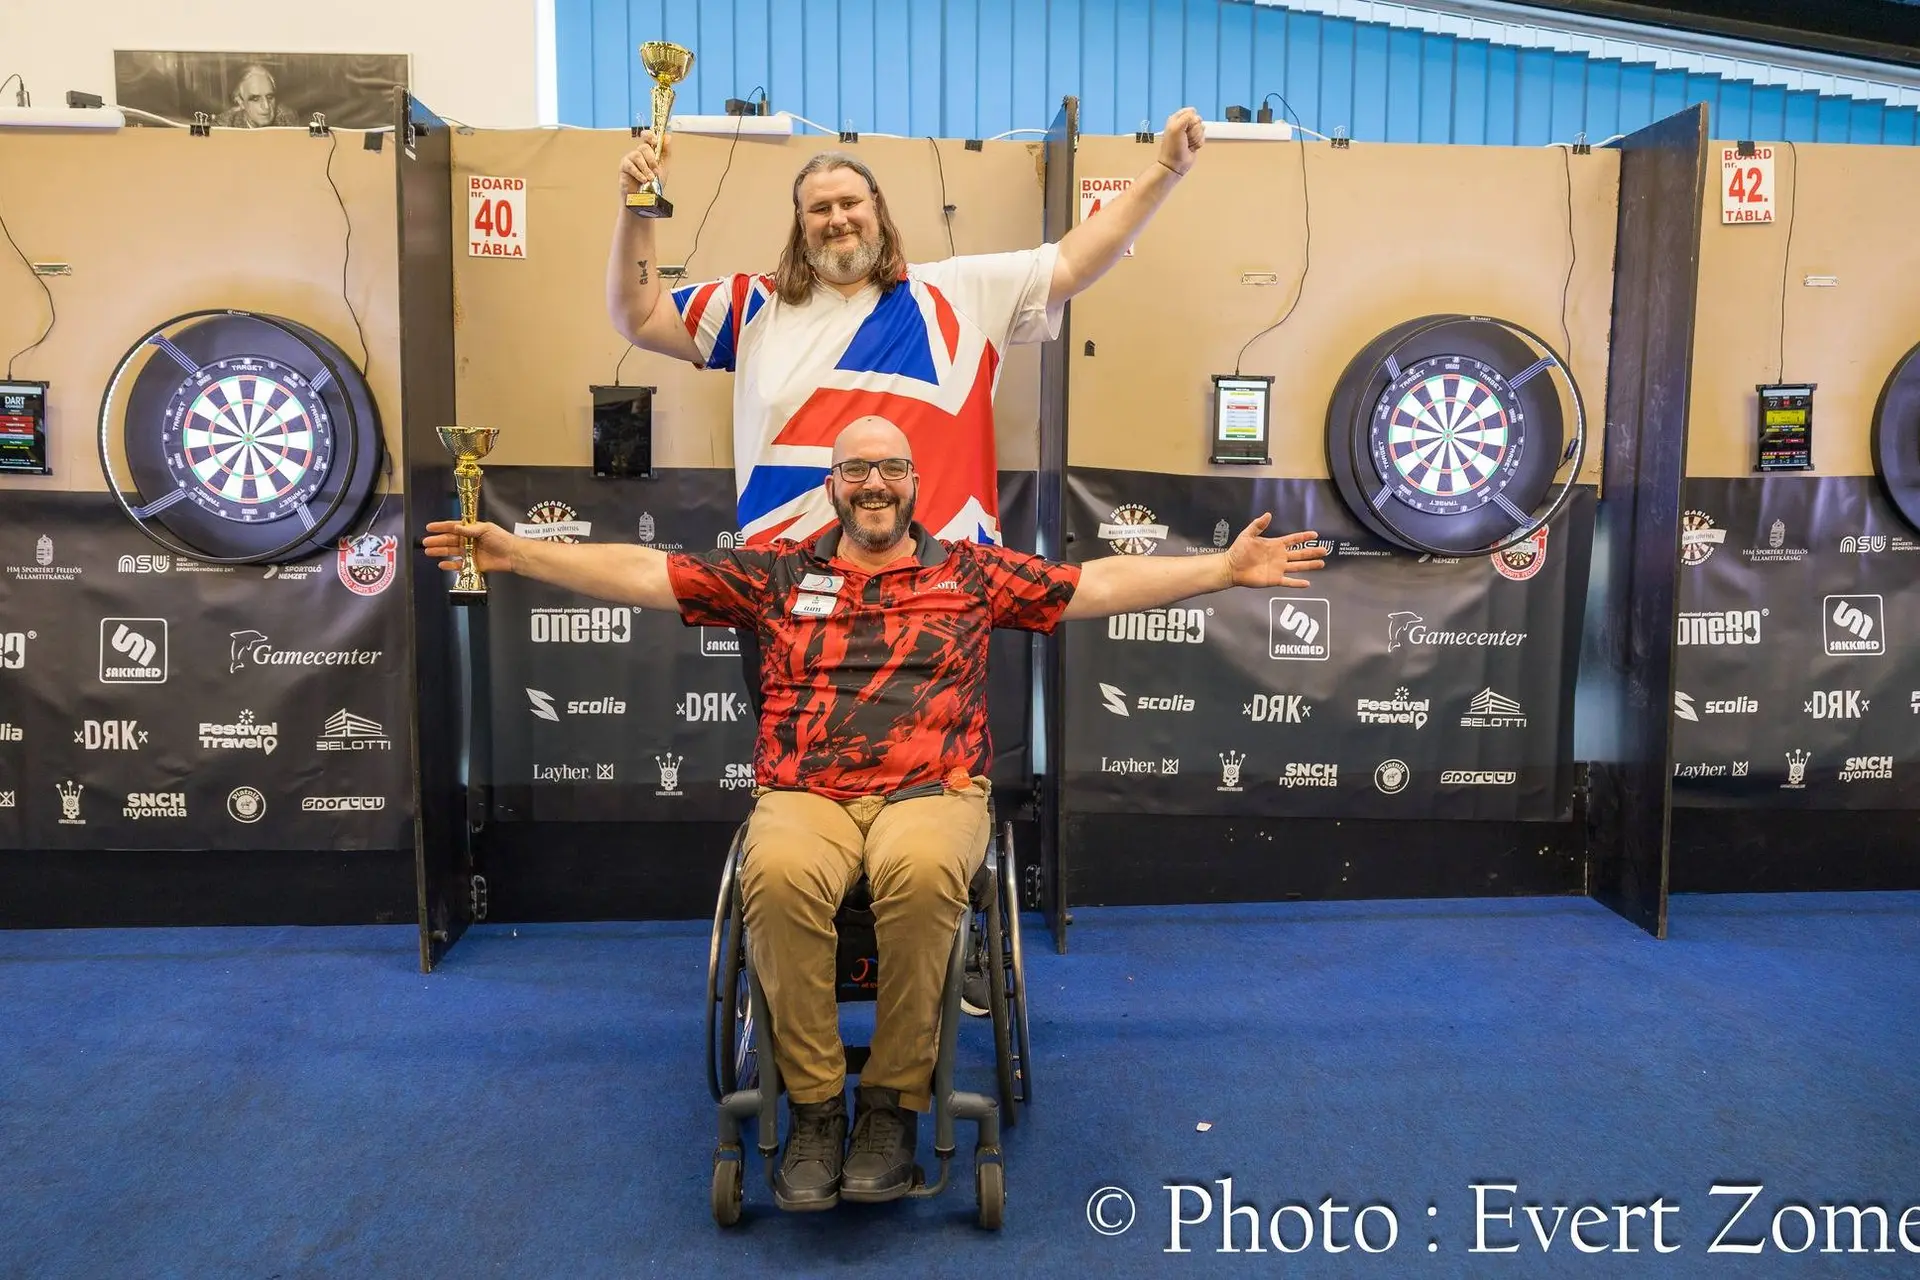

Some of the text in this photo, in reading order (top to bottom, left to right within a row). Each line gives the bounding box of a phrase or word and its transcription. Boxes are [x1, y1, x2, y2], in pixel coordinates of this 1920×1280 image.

[471, 178, 523, 190] BOARD
[1082, 180, 1131, 191] BOARD
[1729, 167, 1768, 203] 42.
[475, 199, 517, 237] 40.
[1725, 207, 1772, 221] TÁBLA
[471, 240, 522, 256] TÁBLA
[1399, 369, 1426, 389] TARGET
[1479, 371, 1503, 393] TARGET
[5, 396, 25, 405] DART
[172, 401, 187, 431] TARGET
[309, 403, 324, 434] TARGET
[1378, 440, 1390, 469] TARGET
[1502, 444, 1517, 473] TARGET
[193, 486, 220, 508] TARGET
[279, 487, 305, 509] TARGET
[527, 500, 577, 518] HUNGARIAN
[1110, 503, 1156, 520] HUNGARIAN
[1684, 509, 1715, 526] GARIAN
[1408, 625, 1527, 647] Gamecenter
[706, 640, 740, 651] SAKK
[1275, 643, 1324, 655] SAKKMED
[1829, 640, 1879, 651] SAKKMED
[252, 645, 382, 665] Gamecenter
[105, 667, 161, 678] SAKKMED
[567, 696, 627, 715] scolia
[1137, 694, 1196, 712] scolia
[1357, 698, 1430, 712] Festival
[1705, 696, 1759, 714] scolia
[1357, 711, 1414, 724] Travel
[1460, 717, 1527, 728] BELOTTI
[0, 723, 23, 741] lia
[199, 721, 278, 736] Festival
[199, 735, 264, 749] Travel
[316, 740, 391, 751] BELOTTI
[725, 764, 756, 778] SN
[1285, 762, 1338, 778] SNCH
[1845, 756, 1893, 771] SNCH
[1279, 773, 1337, 788] nyomda
[1838, 768, 1893, 783] nyomda
[127, 792, 186, 807] SNCH
[122, 804, 187, 820] nyomda
